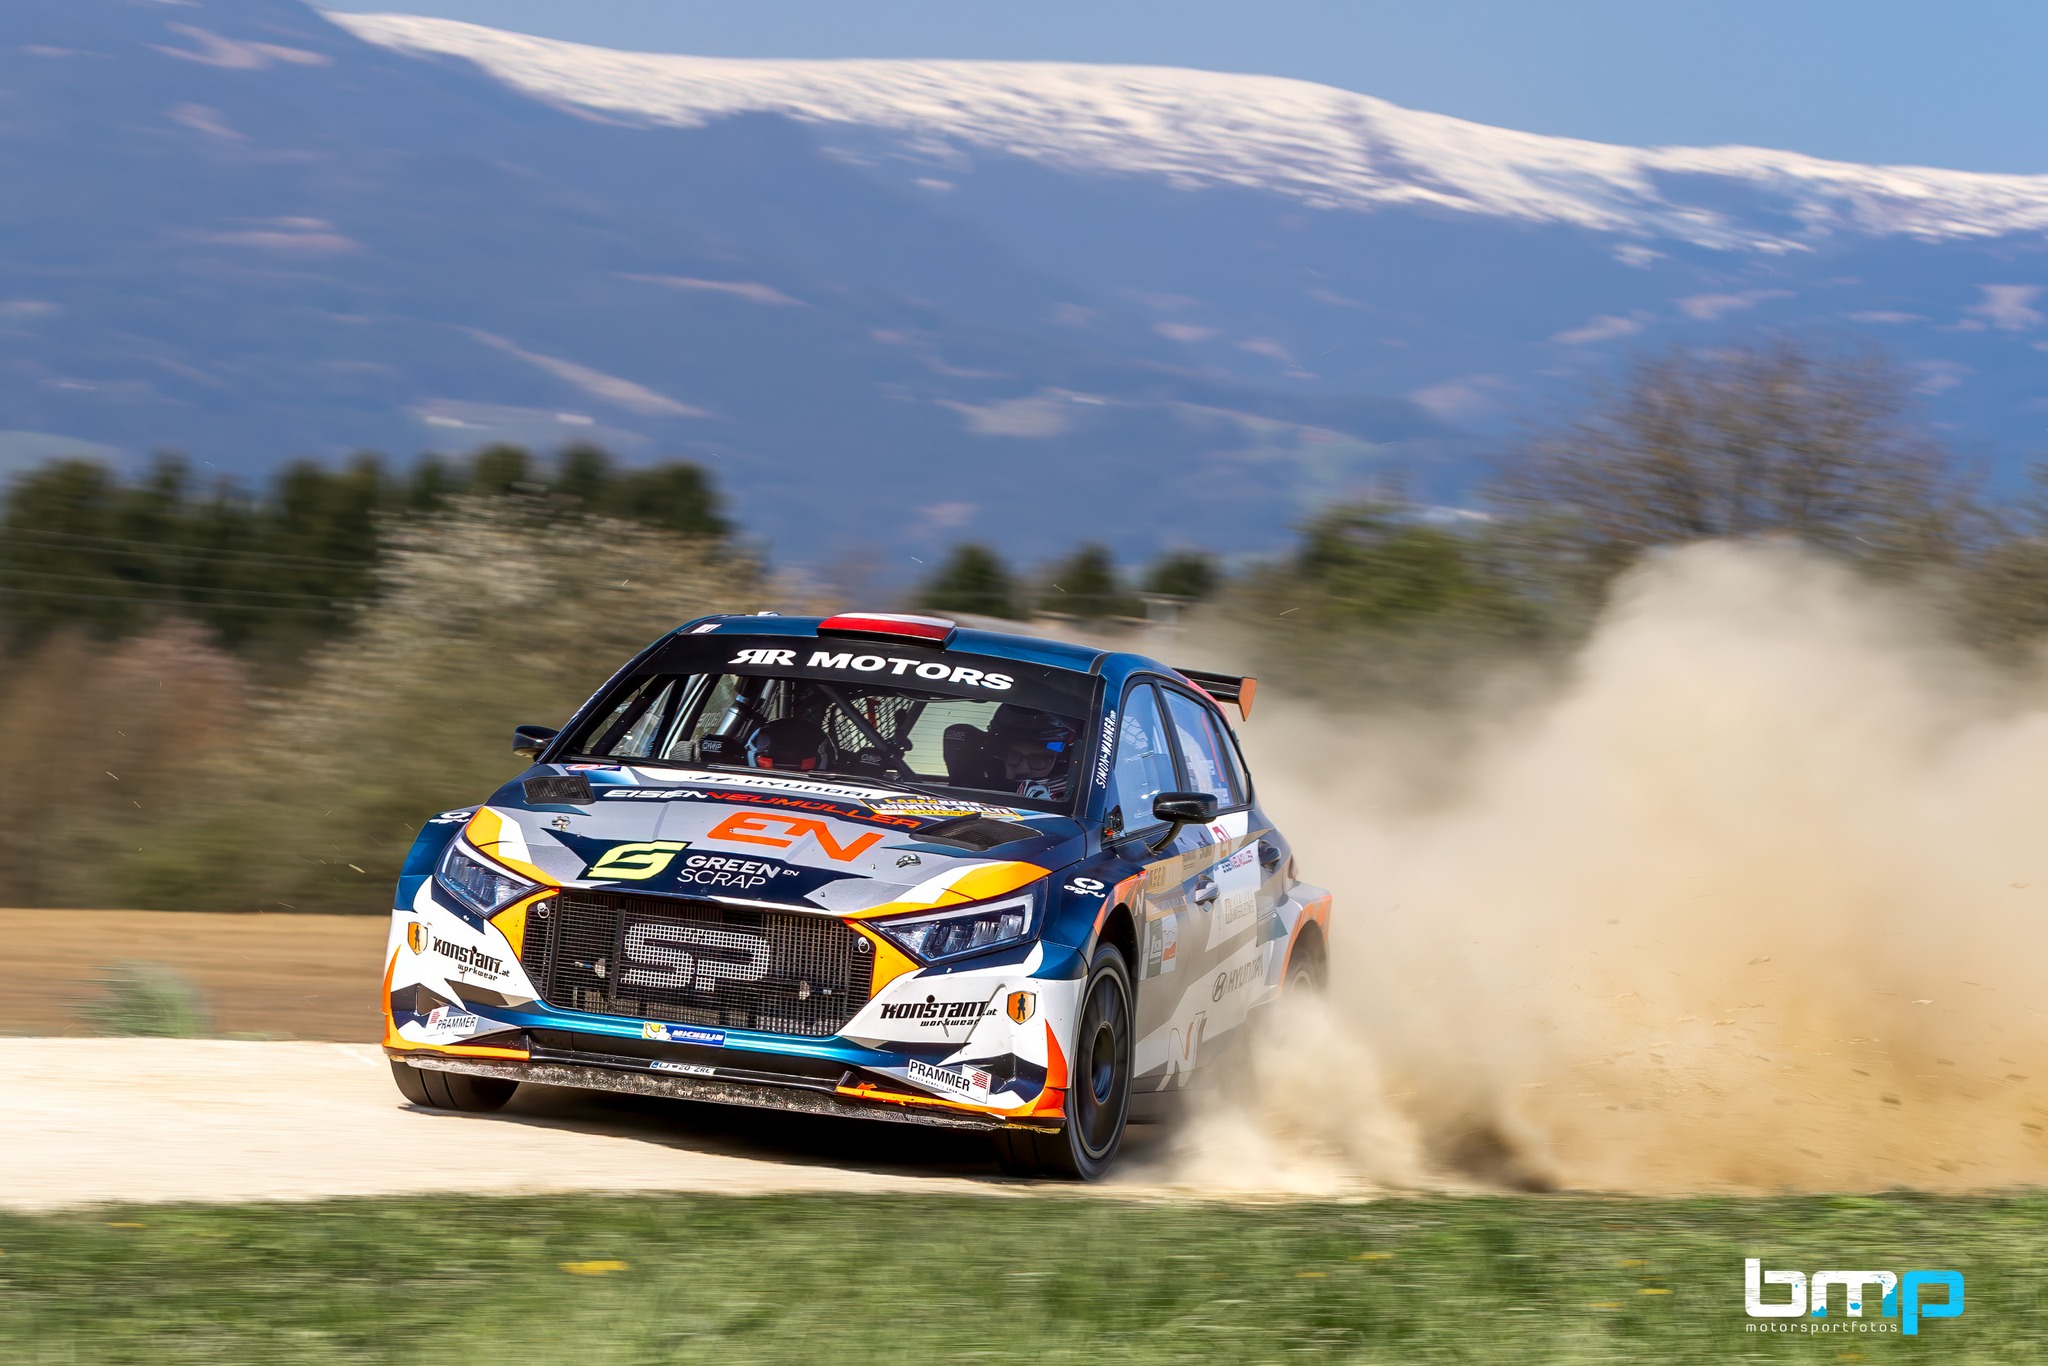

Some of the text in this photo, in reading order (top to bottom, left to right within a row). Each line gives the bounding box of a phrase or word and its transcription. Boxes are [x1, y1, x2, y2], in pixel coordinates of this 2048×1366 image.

[807, 651, 1015, 690] MOTORS
[744, 779, 871, 798] HYUNDAI
[707, 811, 885, 862] EN
[686, 855, 781, 878] GREEN
[677, 868, 766, 889] SCRAP
[620, 923, 770, 992] SP
[457, 963, 498, 981] workwear
[437, 1016, 477, 1030] PRAMMER
[672, 1029, 724, 1041] MICHELIN
[910, 1061, 970, 1091] PRAMMER
